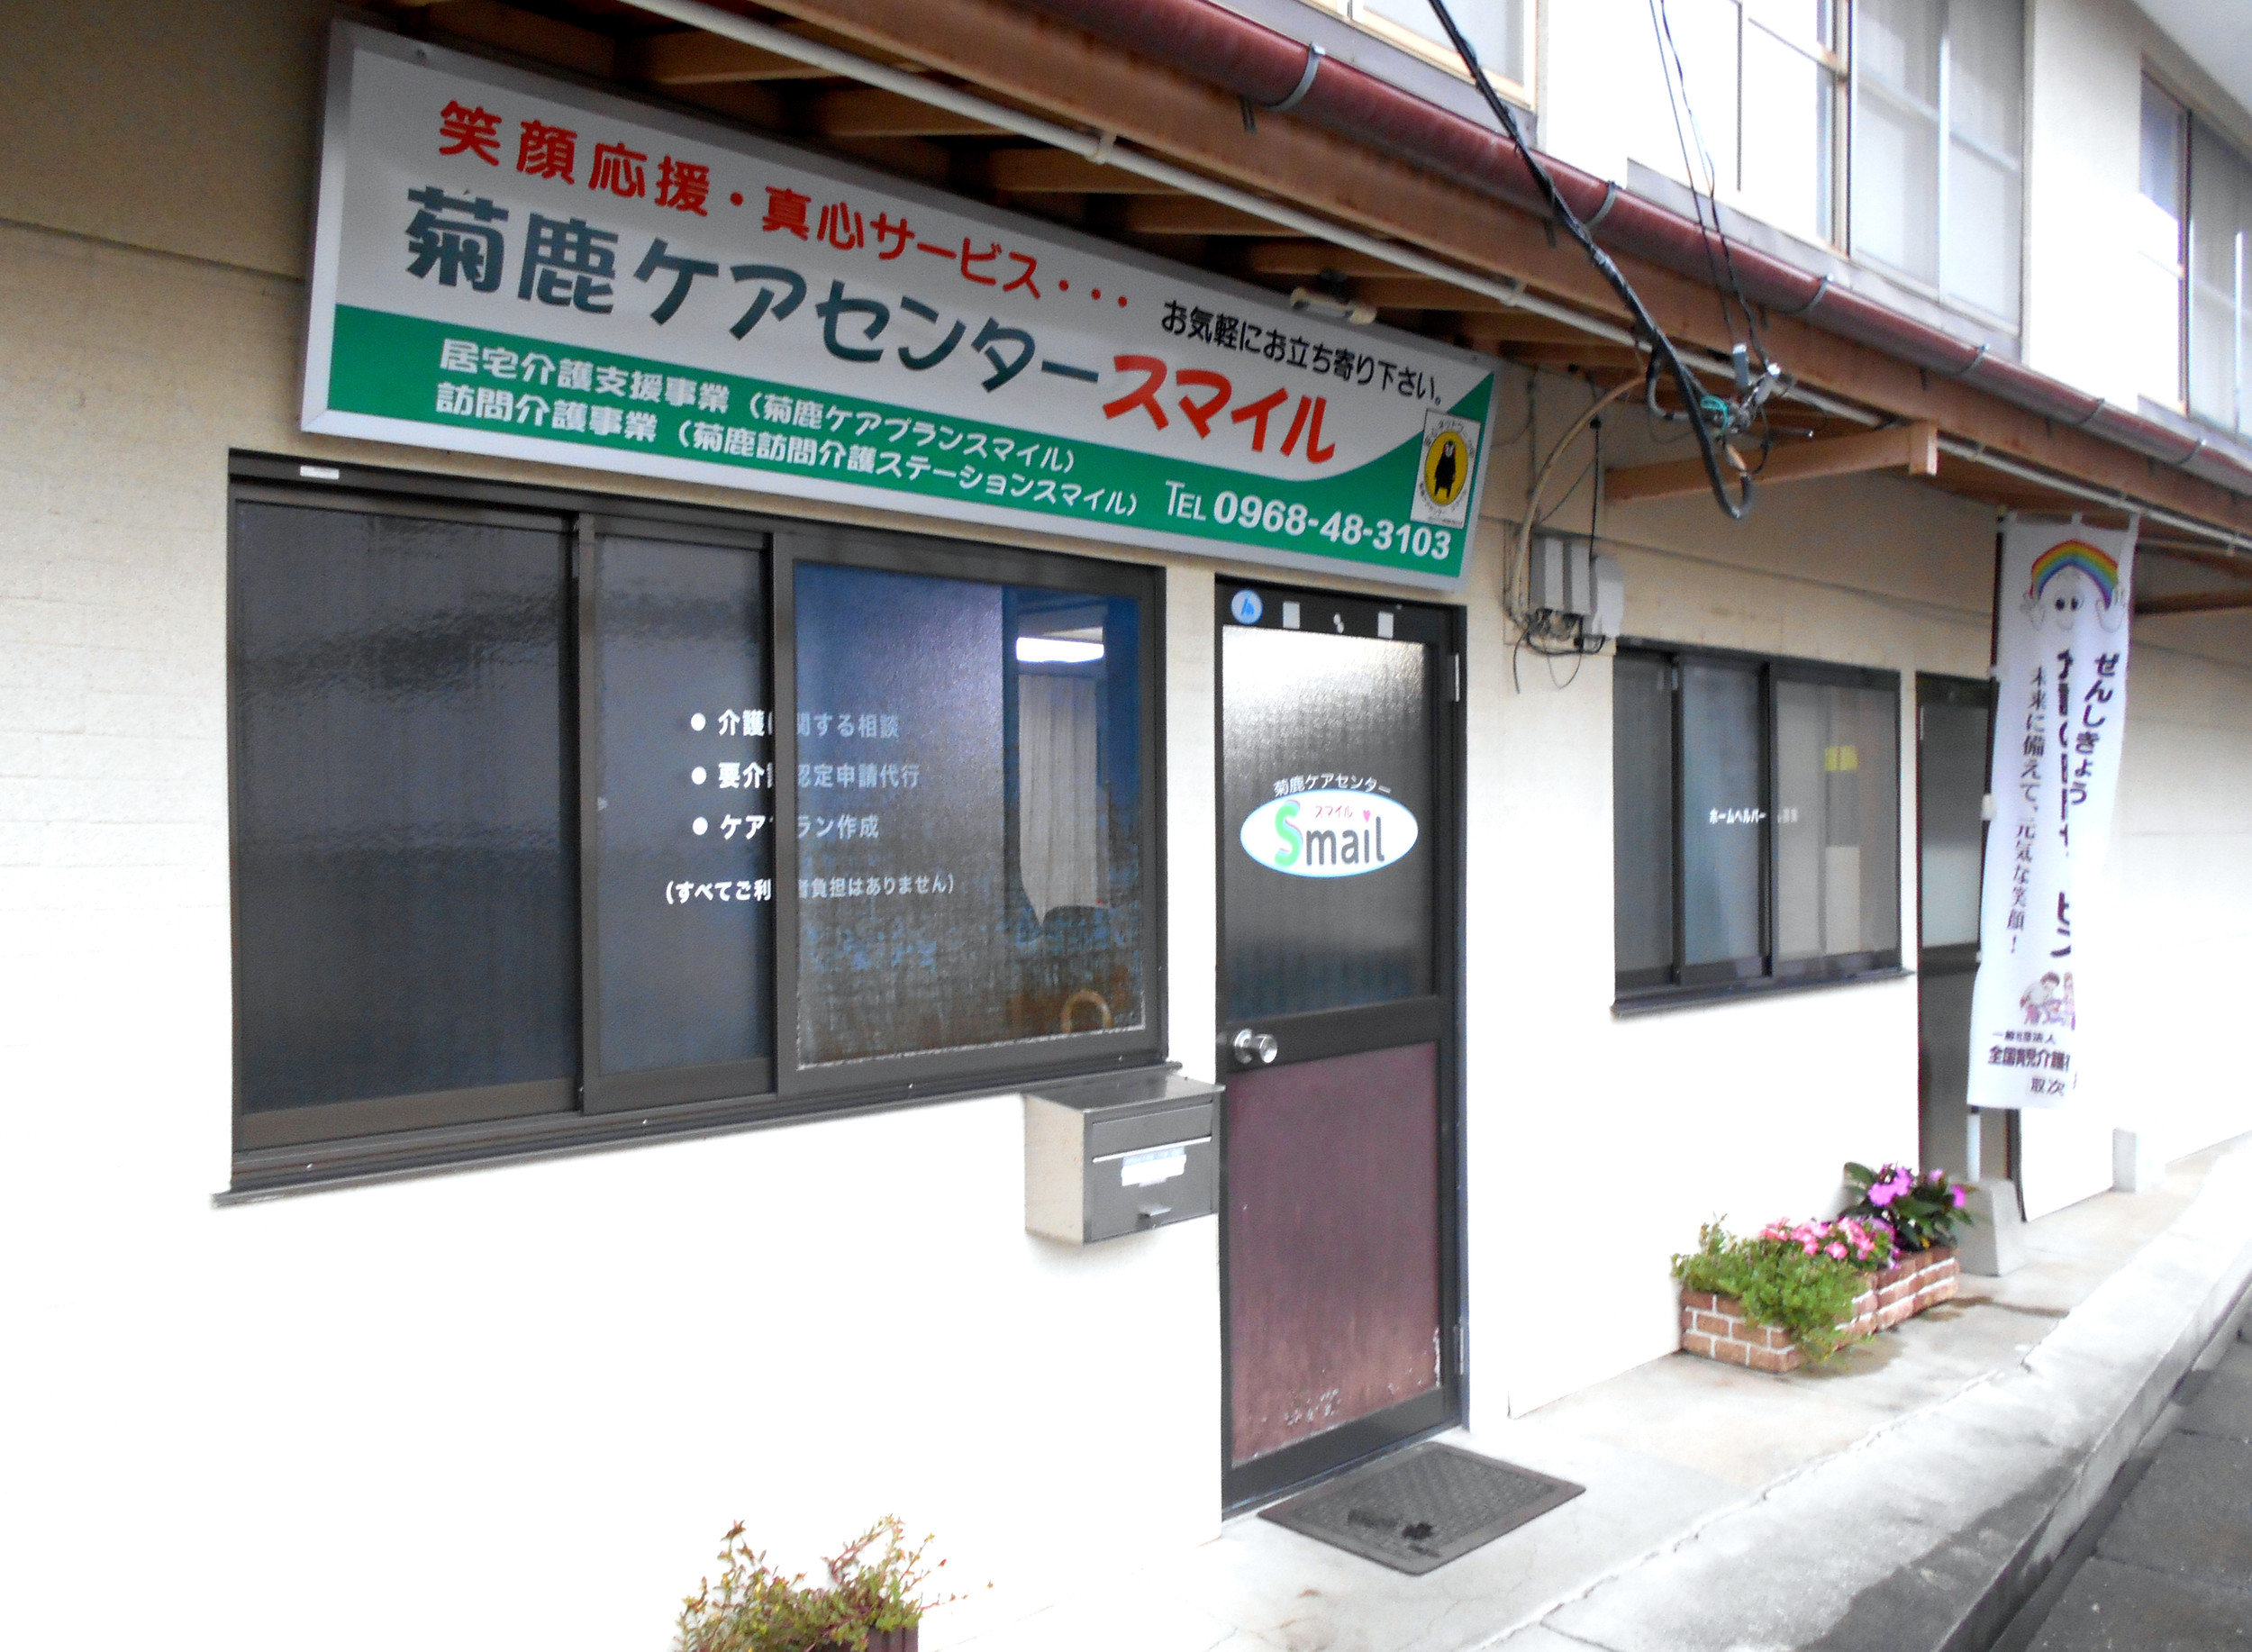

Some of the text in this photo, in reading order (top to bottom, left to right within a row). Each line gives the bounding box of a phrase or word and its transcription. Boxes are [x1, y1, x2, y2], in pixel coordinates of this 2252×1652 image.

[1161, 300, 1441, 405] お気軽にお立ち寄り下さい。
[439, 338, 730, 414] 居宅介護支援事業
[435, 382, 658, 442] 訪問介護事業
[1166, 480, 1206, 521] TEL
[1213, 490, 1452, 560] 0968-48-3103
[718, 709, 900, 738] 介護関する相談
[718, 762, 920, 789] 要介認定申請代行
[1273, 772, 1391, 797] 菊鹿ケアセンター
[720, 814, 880, 840] ケアラン作成
[1275, 799, 1385, 867] Smail
[1315, 805, 1354, 820] スマイル
